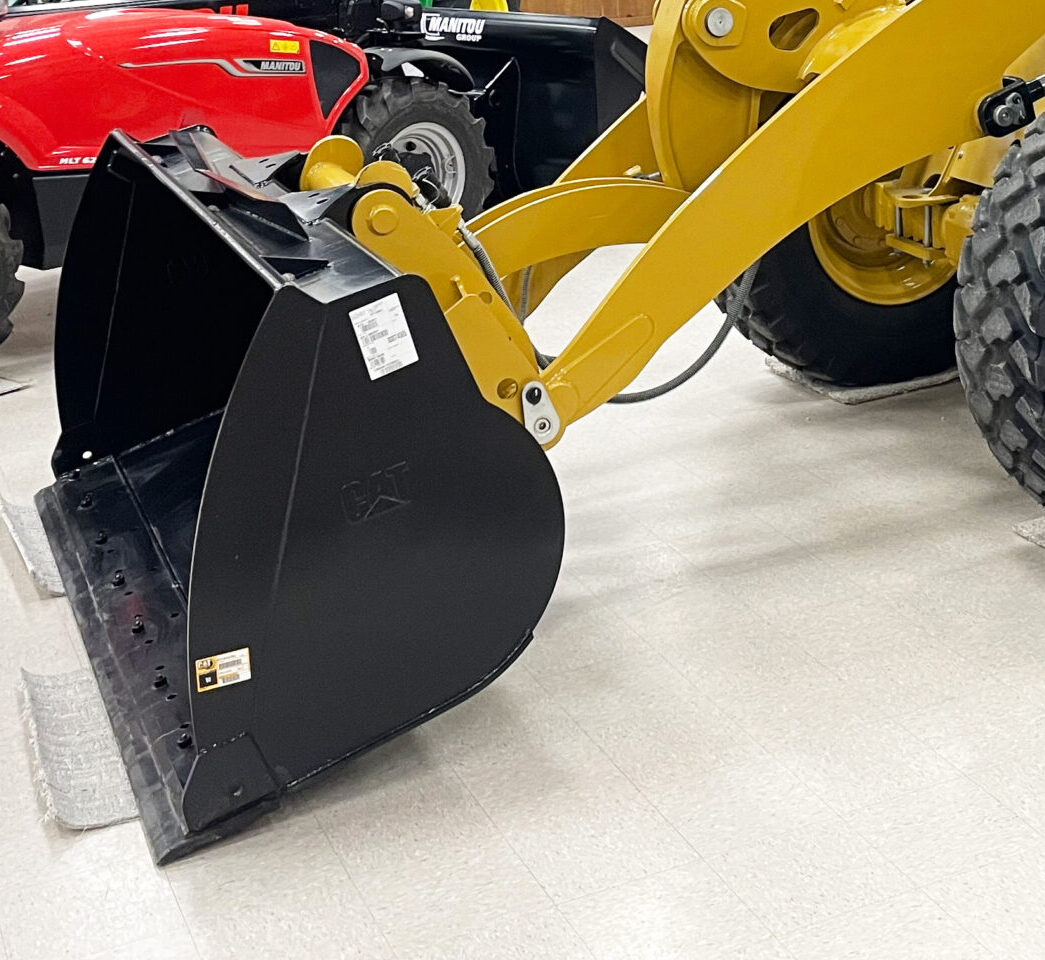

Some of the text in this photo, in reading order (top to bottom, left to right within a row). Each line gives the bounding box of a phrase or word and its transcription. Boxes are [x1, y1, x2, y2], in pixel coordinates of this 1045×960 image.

[428, 16, 486, 34] MANITOU
[455, 33, 482, 42] GROUP
[260, 61, 301, 71] MANITOU
[340, 460, 410, 526] CAT
